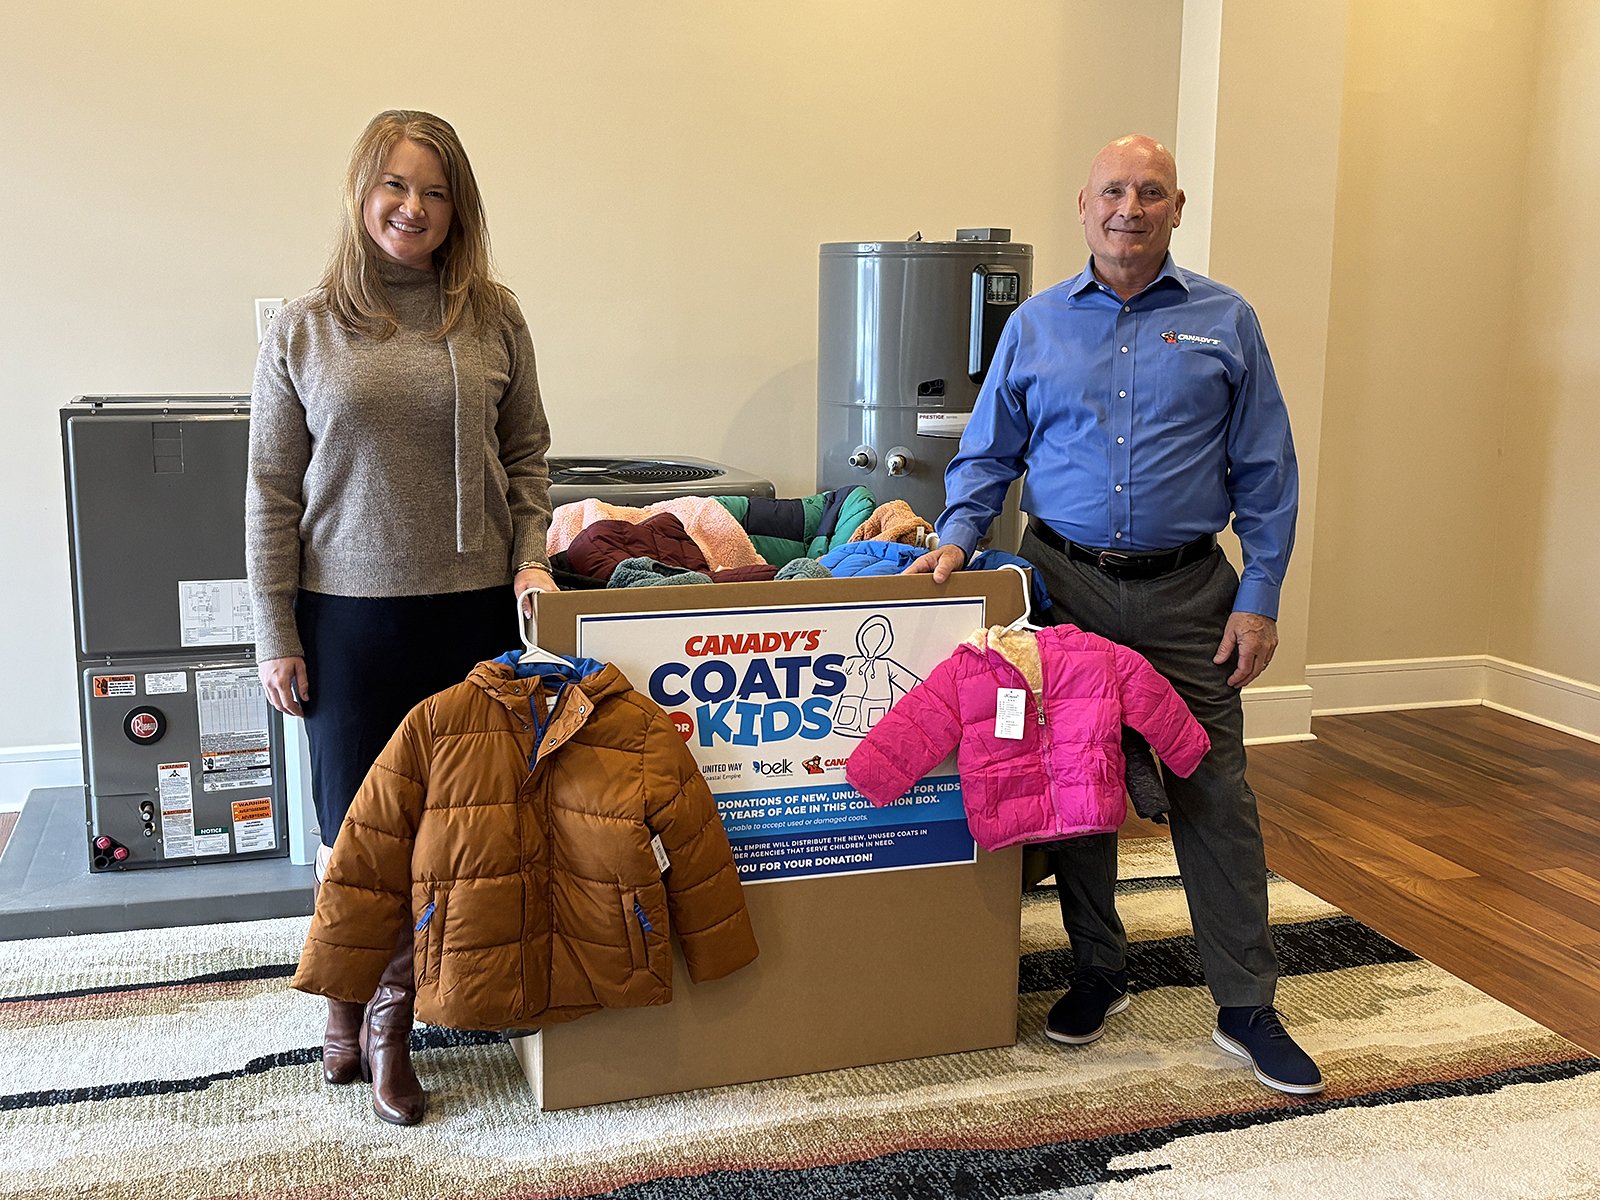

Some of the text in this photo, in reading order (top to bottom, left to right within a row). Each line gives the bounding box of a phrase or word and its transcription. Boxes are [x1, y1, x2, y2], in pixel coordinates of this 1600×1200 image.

[1178, 334, 1219, 344] CANADY'S
[685, 629, 822, 658] CANADY'S
[648, 654, 847, 706] COATS
[134, 716, 156, 734] Rheem
[696, 697, 833, 747] KIDS
[702, 762, 743, 773] UNITED WAY
[760, 758, 793, 775] belk
[913, 785, 935, 794] FOR
[936, 782, 961, 792] KIDS
[239, 800, 270, 808] WARNING
[717, 790, 865, 809] DONATIONS OF NEW, UNUS
[729, 808, 765, 820] YEARS
[767, 807, 783, 817] OF
[784, 805, 807, 815] AGE
[809, 804, 821, 813] IN
[822, 802, 847, 812] THIS
[915, 795, 940, 805] BOX.
[200, 827, 222, 835] NOTICE
[727, 824, 752, 832] unable
[761, 820, 786, 830] accept
[787, 818, 804, 827] used
[813, 815, 848, 826] damaged
[847, 814, 869, 823] coats.
[744, 843, 771, 851] EMPIRE
[772, 841, 790, 849] WILL
[791, 837, 832, 847] DISTRIBUTE
[833, 835, 847, 843] THE
[867, 831, 896, 840] UNUSED
[896, 830, 919, 838] COATS
[750, 848, 785, 858] AGENCIES
[786, 847, 805, 855] THAT
[805, 844, 828, 853] SERVE
[829, 841, 864, 851] CHILDREN
[874, 839, 895, 847] NEED.
[736, 852, 873, 874] YOU FOR YOUR DONATION!
